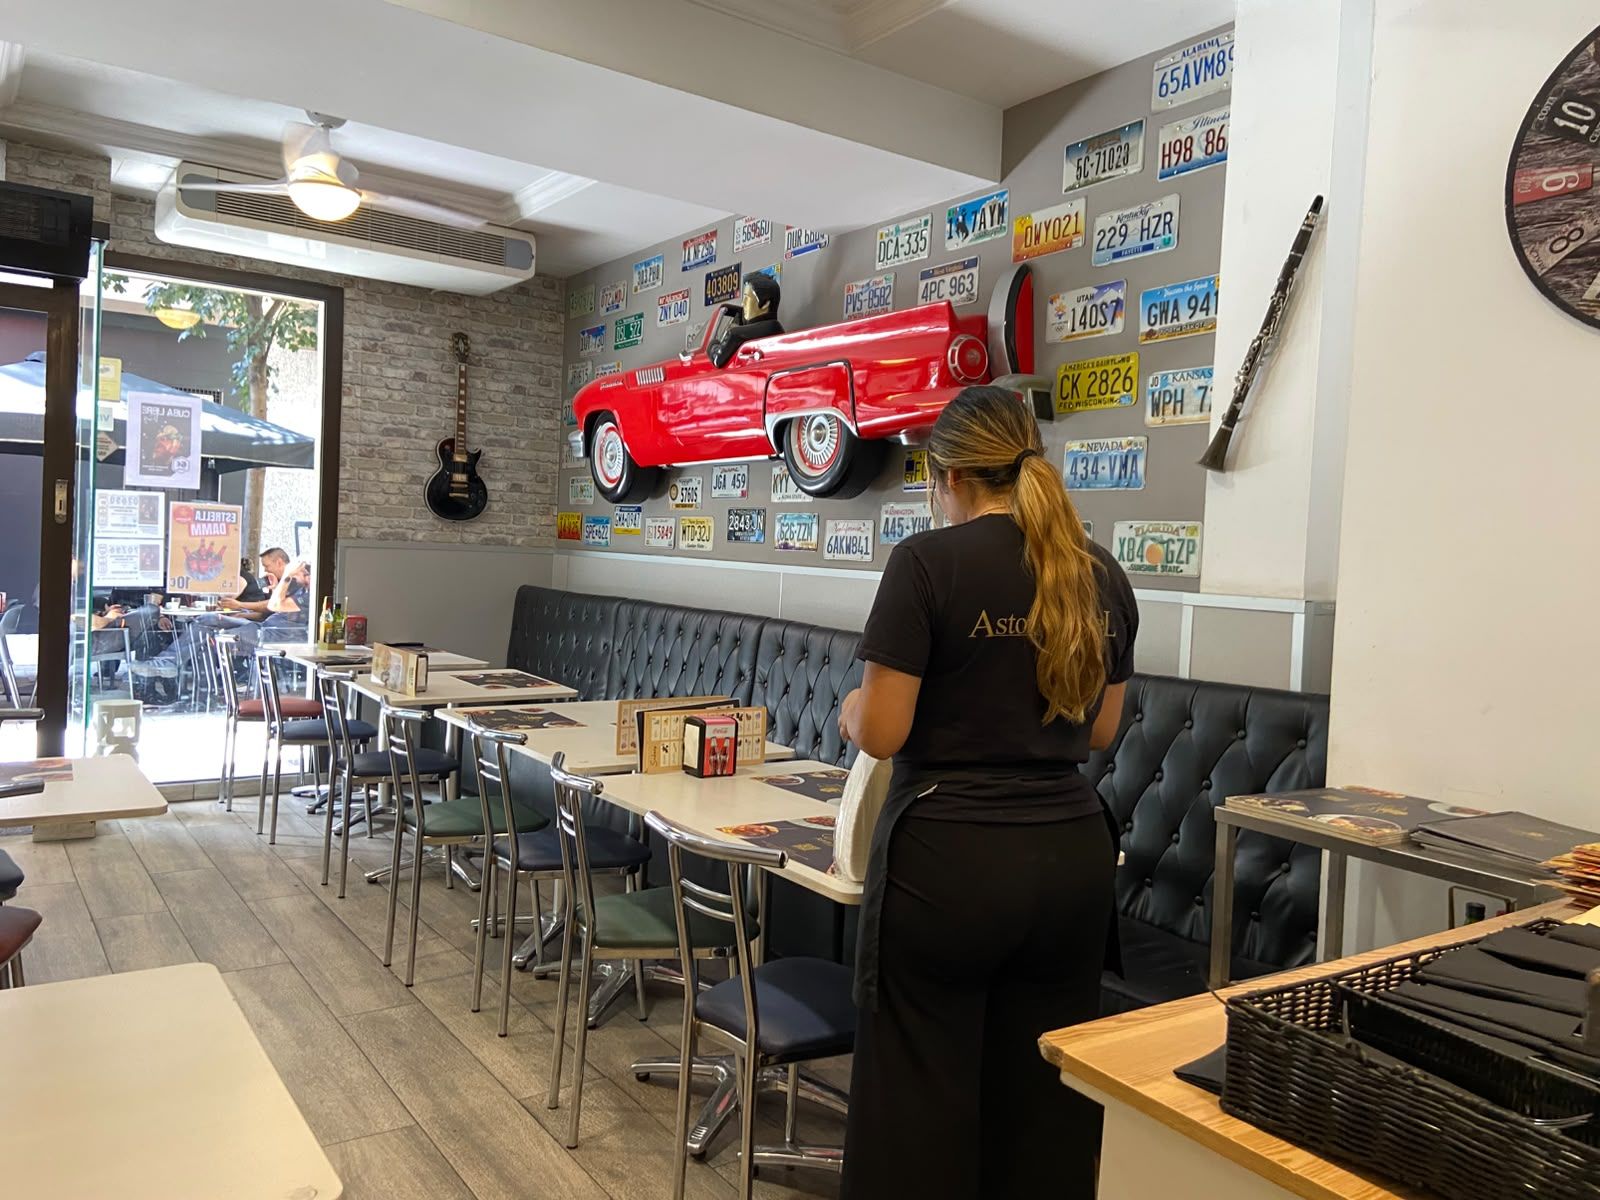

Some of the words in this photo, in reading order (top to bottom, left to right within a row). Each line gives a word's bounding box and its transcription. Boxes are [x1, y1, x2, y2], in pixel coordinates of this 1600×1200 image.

[1182, 38, 1220, 57] ALABAMA
[1553, 101, 1597, 135] 10
[1161, 136, 1193, 170] H98
[1205, 124, 1229, 157] 86
[1542, 171, 1580, 192] 9
[1116, 206, 1150, 225] Kentucky
[878, 228, 928, 263] DCA-335
[1096, 223, 1128, 252] 229
[1139, 211, 1173, 242] HZR
[1550, 226, 1585, 254] 8
[921, 279, 945, 302] 4PC
[949, 272, 974, 297] 963
[1076, 293, 1095, 303] UTAH
[1147, 298, 1180, 327] GWA
[1059, 372, 1082, 401] CK
[1086, 366, 1134, 397] 2826
[1172, 368, 1213, 383] KANSAS
[1151, 388, 1185, 418] WPH
[1087, 442, 1124, 453] NEVADA
[713, 474, 726, 490] JGA
[731, 473, 746, 490] 459
[826, 535, 870, 556] 6AKW841
[1118, 536, 1145, 563] X84
[1164, 538, 1197, 565] GZP
[968, 610, 1030, 638] Asto
